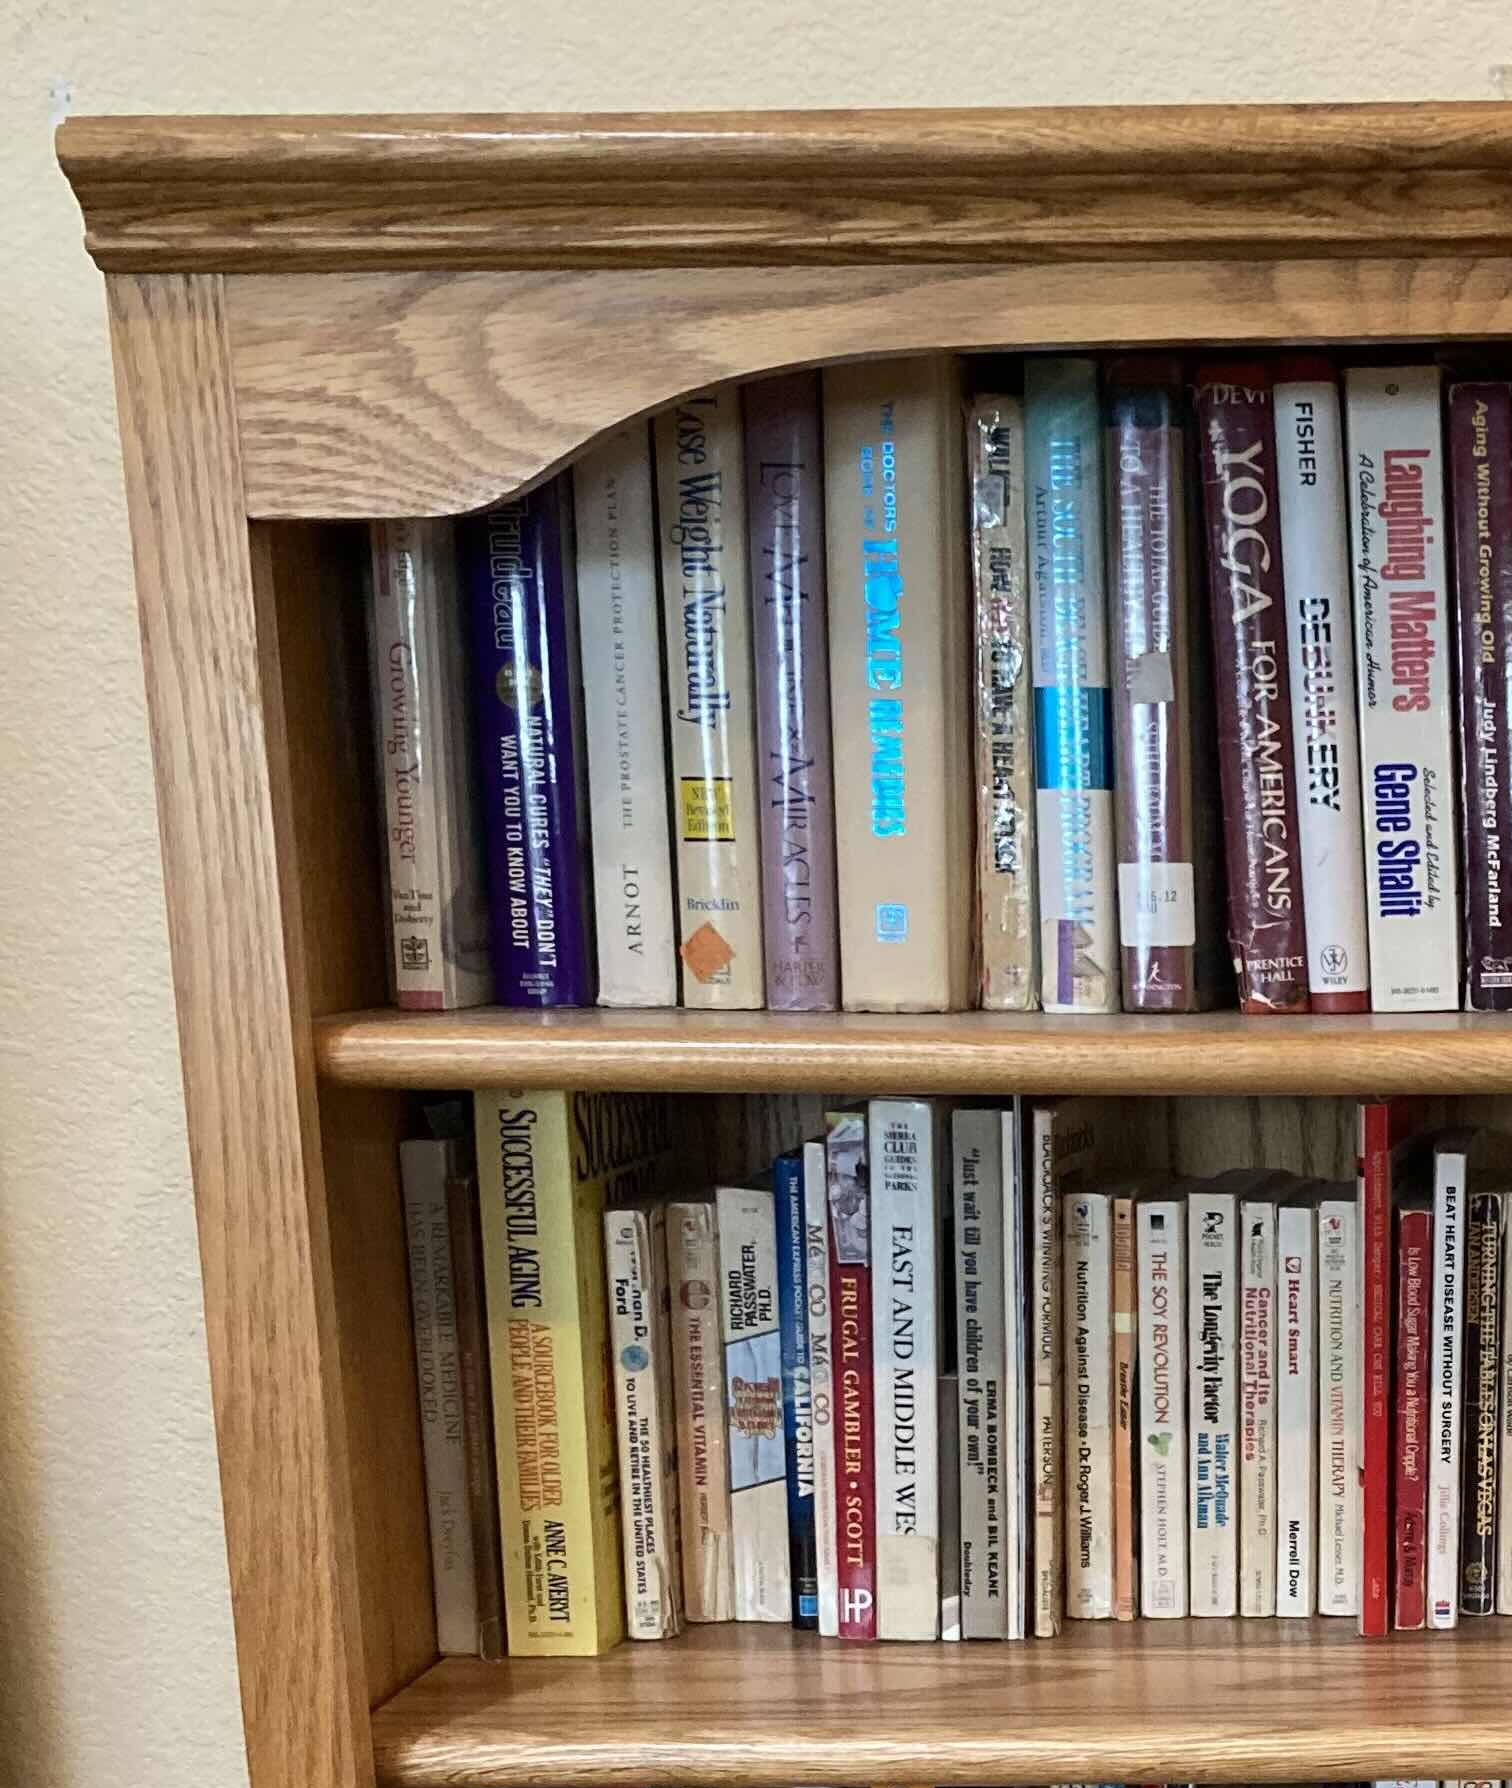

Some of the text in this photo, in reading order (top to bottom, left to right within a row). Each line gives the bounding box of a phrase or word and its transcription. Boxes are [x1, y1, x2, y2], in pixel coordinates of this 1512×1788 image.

[1295, 403, 1316, 487] FISHER
[1471, 400, 1495, 664] Aging Without Growing Old
[1378, 449, 1436, 713] Laughing Matters
[1220, 441, 1290, 911] YOGA FOR AMERICANS
[1375, 763, 1422, 917] Gene Shalit
[624, 864, 643, 956] ARNOT
[686, 896, 740, 911] Bricklin
[499, 1109, 542, 1308] SUCCESSFUL AGING
[615, 1278, 630, 1316] Ford
[1287, 1279, 1299, 1376] Heart Smart
[1440, 1186, 1456, 1463] BEAT HEART DISEASE WITHOUT SURGERY
[625, 1377, 636, 1391] TO
[626, 1394, 638, 1416] LIVE
[891, 1226, 917, 1534] EAST AND MIDDLE WES
[628, 1419, 639, 1444] AND
[629, 1446, 641, 1479] RETIRE
[840, 1278, 864, 1568] FRUGAL GAMBLER SCOTT
[631, 1482, 641, 1495] IN
[632, 1498, 642, 1515] THE
[986, 1380, 999, 1597] ERMA BOMBECK and BIL KEANE
[633, 1520, 645, 1557] UNITED
[635, 1561, 646, 1594] STATES
[1289, 1520, 1299, 1598] Merrell Dow
